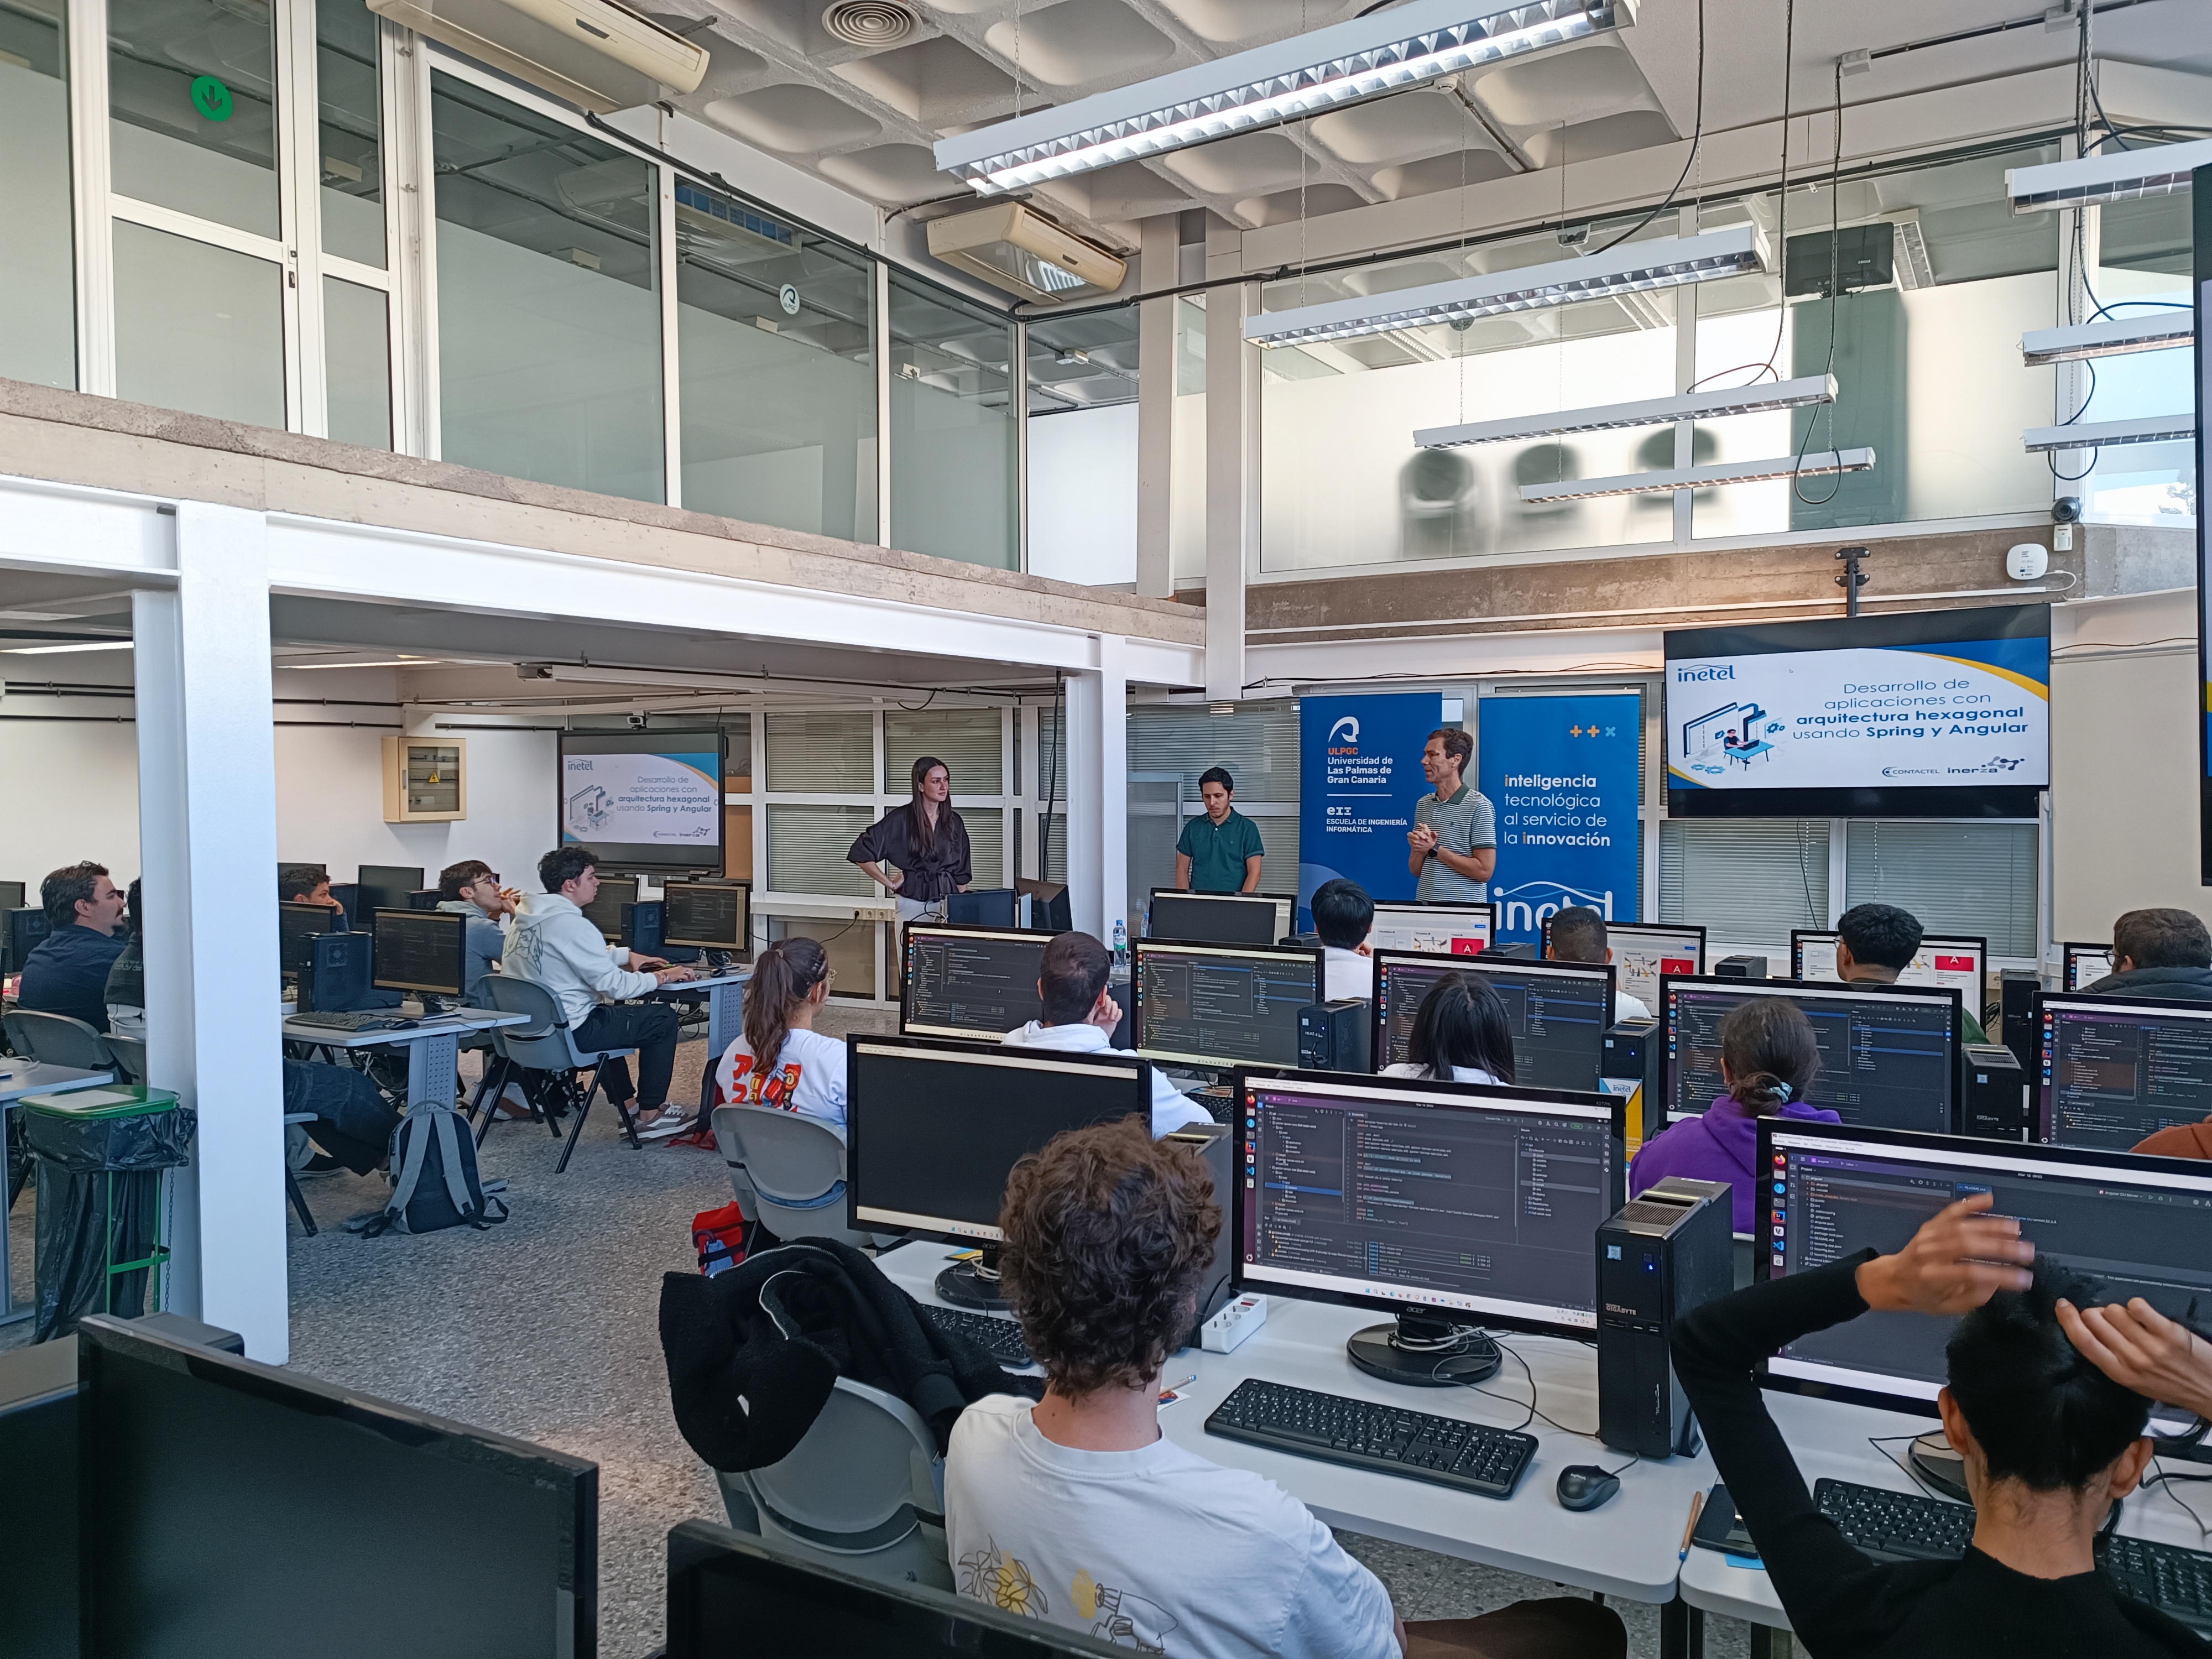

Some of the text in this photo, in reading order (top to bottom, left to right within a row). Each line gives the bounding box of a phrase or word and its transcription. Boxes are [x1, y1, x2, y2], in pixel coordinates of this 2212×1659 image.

[1678, 665, 1736, 682] inetel
[1844, 678, 1970, 694] Desarrollo de
[1824, 693, 1991, 710] aplicaciones con
[1796, 707, 2023, 728] arquitectura hexagonal
[1793, 722, 2028, 739] usando Spring y Angular
[1328, 747, 1359, 755] ULPGC
[568, 759, 593, 770] inetel
[1327, 757, 1393, 765] Universidad de
[1327, 766, 1391, 775] Las Palmas de
[1947, 764, 1998, 774] inerza
[1327, 775, 1386, 784] Gran Canaria
[1505, 774, 1597, 791] inteligencia
[1505, 793, 1600, 810] tecnológica
[680, 805, 712, 813] Angular
[1368, 817, 1408, 826] INGENIERÍA
[1505, 813, 1607, 827] al servicio de
[1326, 825, 1373, 833] INFORMÁTICA
[1504, 831, 1610, 847] la innovación
[1606, 1304, 1637, 1316] GIGABYTE
[1505, 1434, 1527, 1442] logitech
